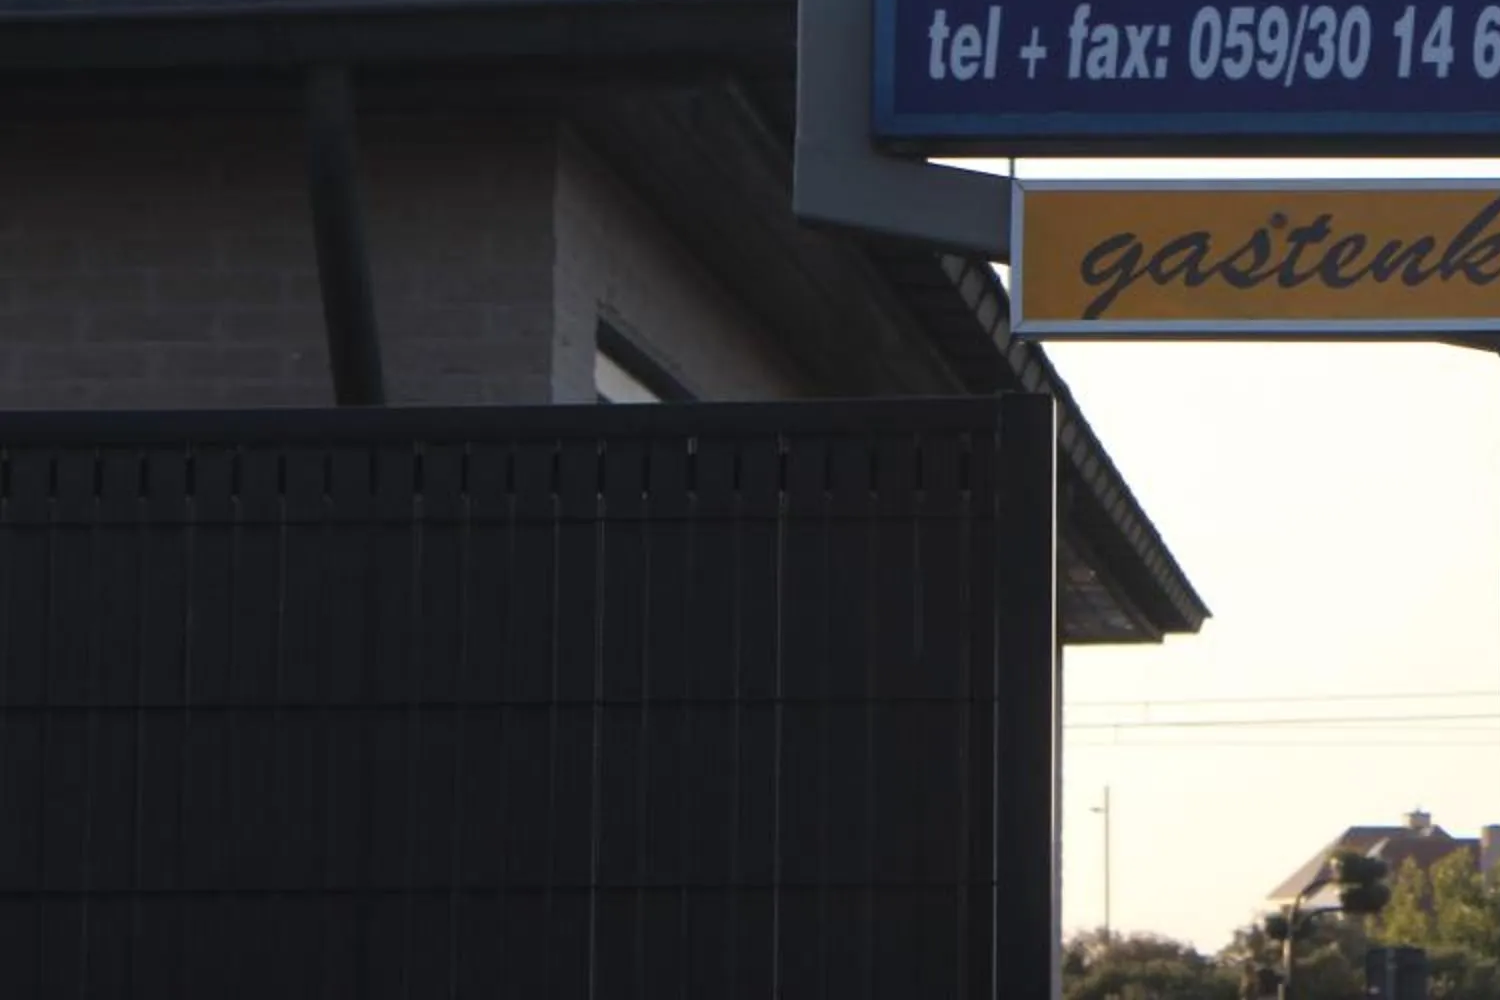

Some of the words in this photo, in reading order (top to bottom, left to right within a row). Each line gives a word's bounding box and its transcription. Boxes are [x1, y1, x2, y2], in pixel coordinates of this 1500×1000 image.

[928, 5, 1002, 81] tel
[1020, 26, 1047, 79] +
[1068, 3, 1171, 80] fax:
[1189, 4, 1372, 87] 059/30
[1393, 5, 1455, 79] 14
